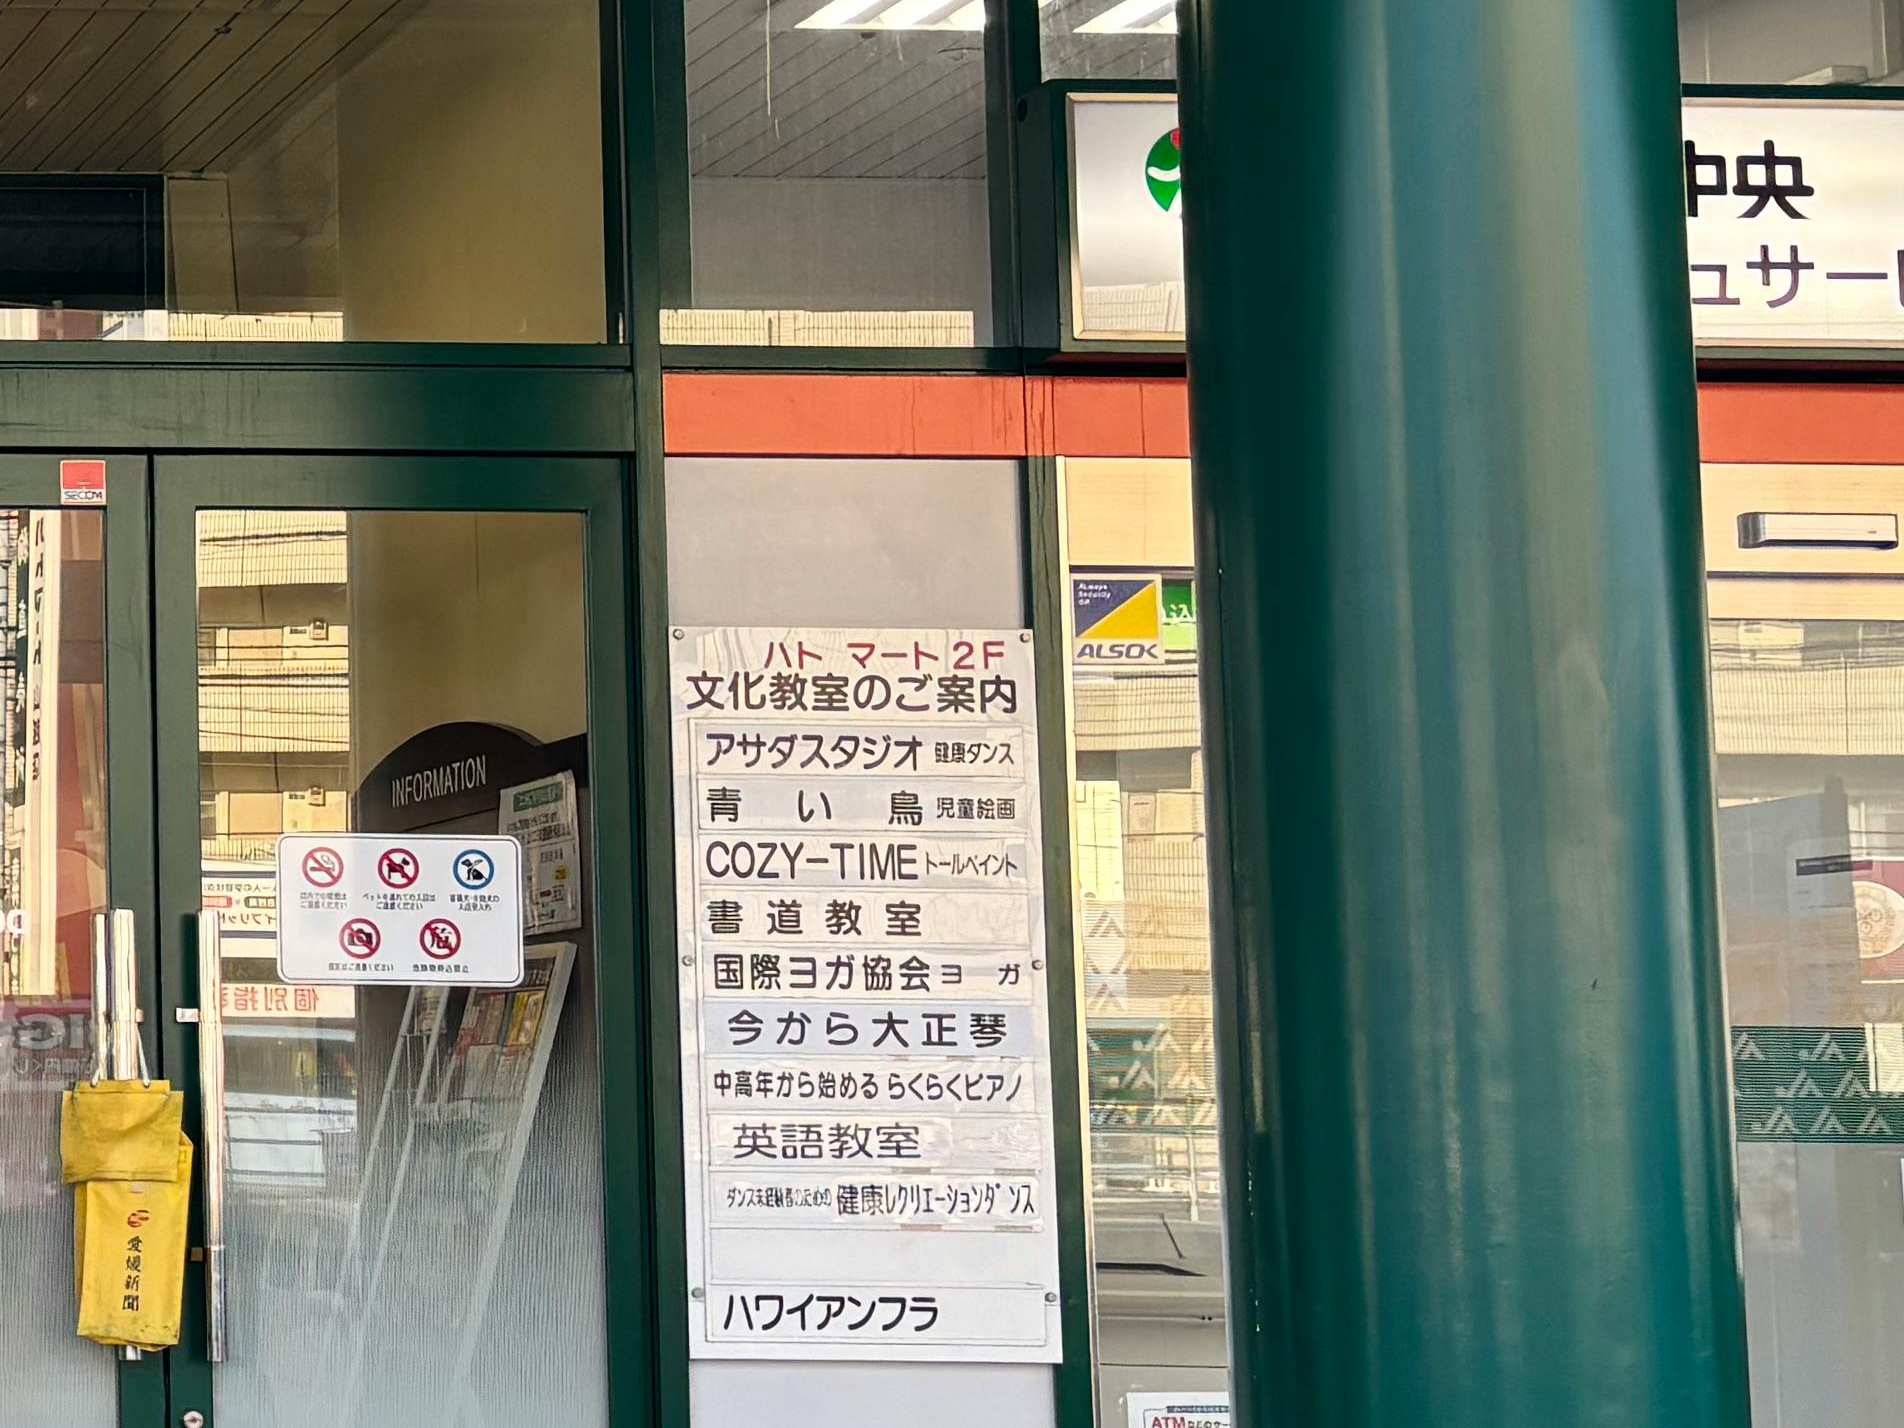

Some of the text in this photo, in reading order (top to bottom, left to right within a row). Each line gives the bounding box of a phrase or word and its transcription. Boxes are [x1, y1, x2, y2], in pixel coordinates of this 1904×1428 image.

[1685, 139, 1815, 220] 中央
[1691, 244, 1904, 310] ュサー
[64, 490, 103, 500] SECOM
[764, 639, 1006, 670] ハト マート 2F
[1076, 643, 1159, 660] ALSOK
[686, 670, 1018, 714] 文化教室のご案内
[706, 731, 1015, 772] アサダスタジオ 健康ダンス
[392, 755, 487, 808] INFORMATION
[936, 796, 1016, 820] 児童絵画
[706, 841, 1018, 881] COZY-TIME トールペイント
[706, 899, 923, 938] 書道教室
[714, 953, 931, 992] 国際ヨガ協会
[727, 1009, 1008, 1049] 今から大正琴
[733, 1122, 922, 1161] 英語教室
[122, 1236, 143, 1311] 愛媛新聞
[723, 1293, 939, 1333] ハワイアンフラ
